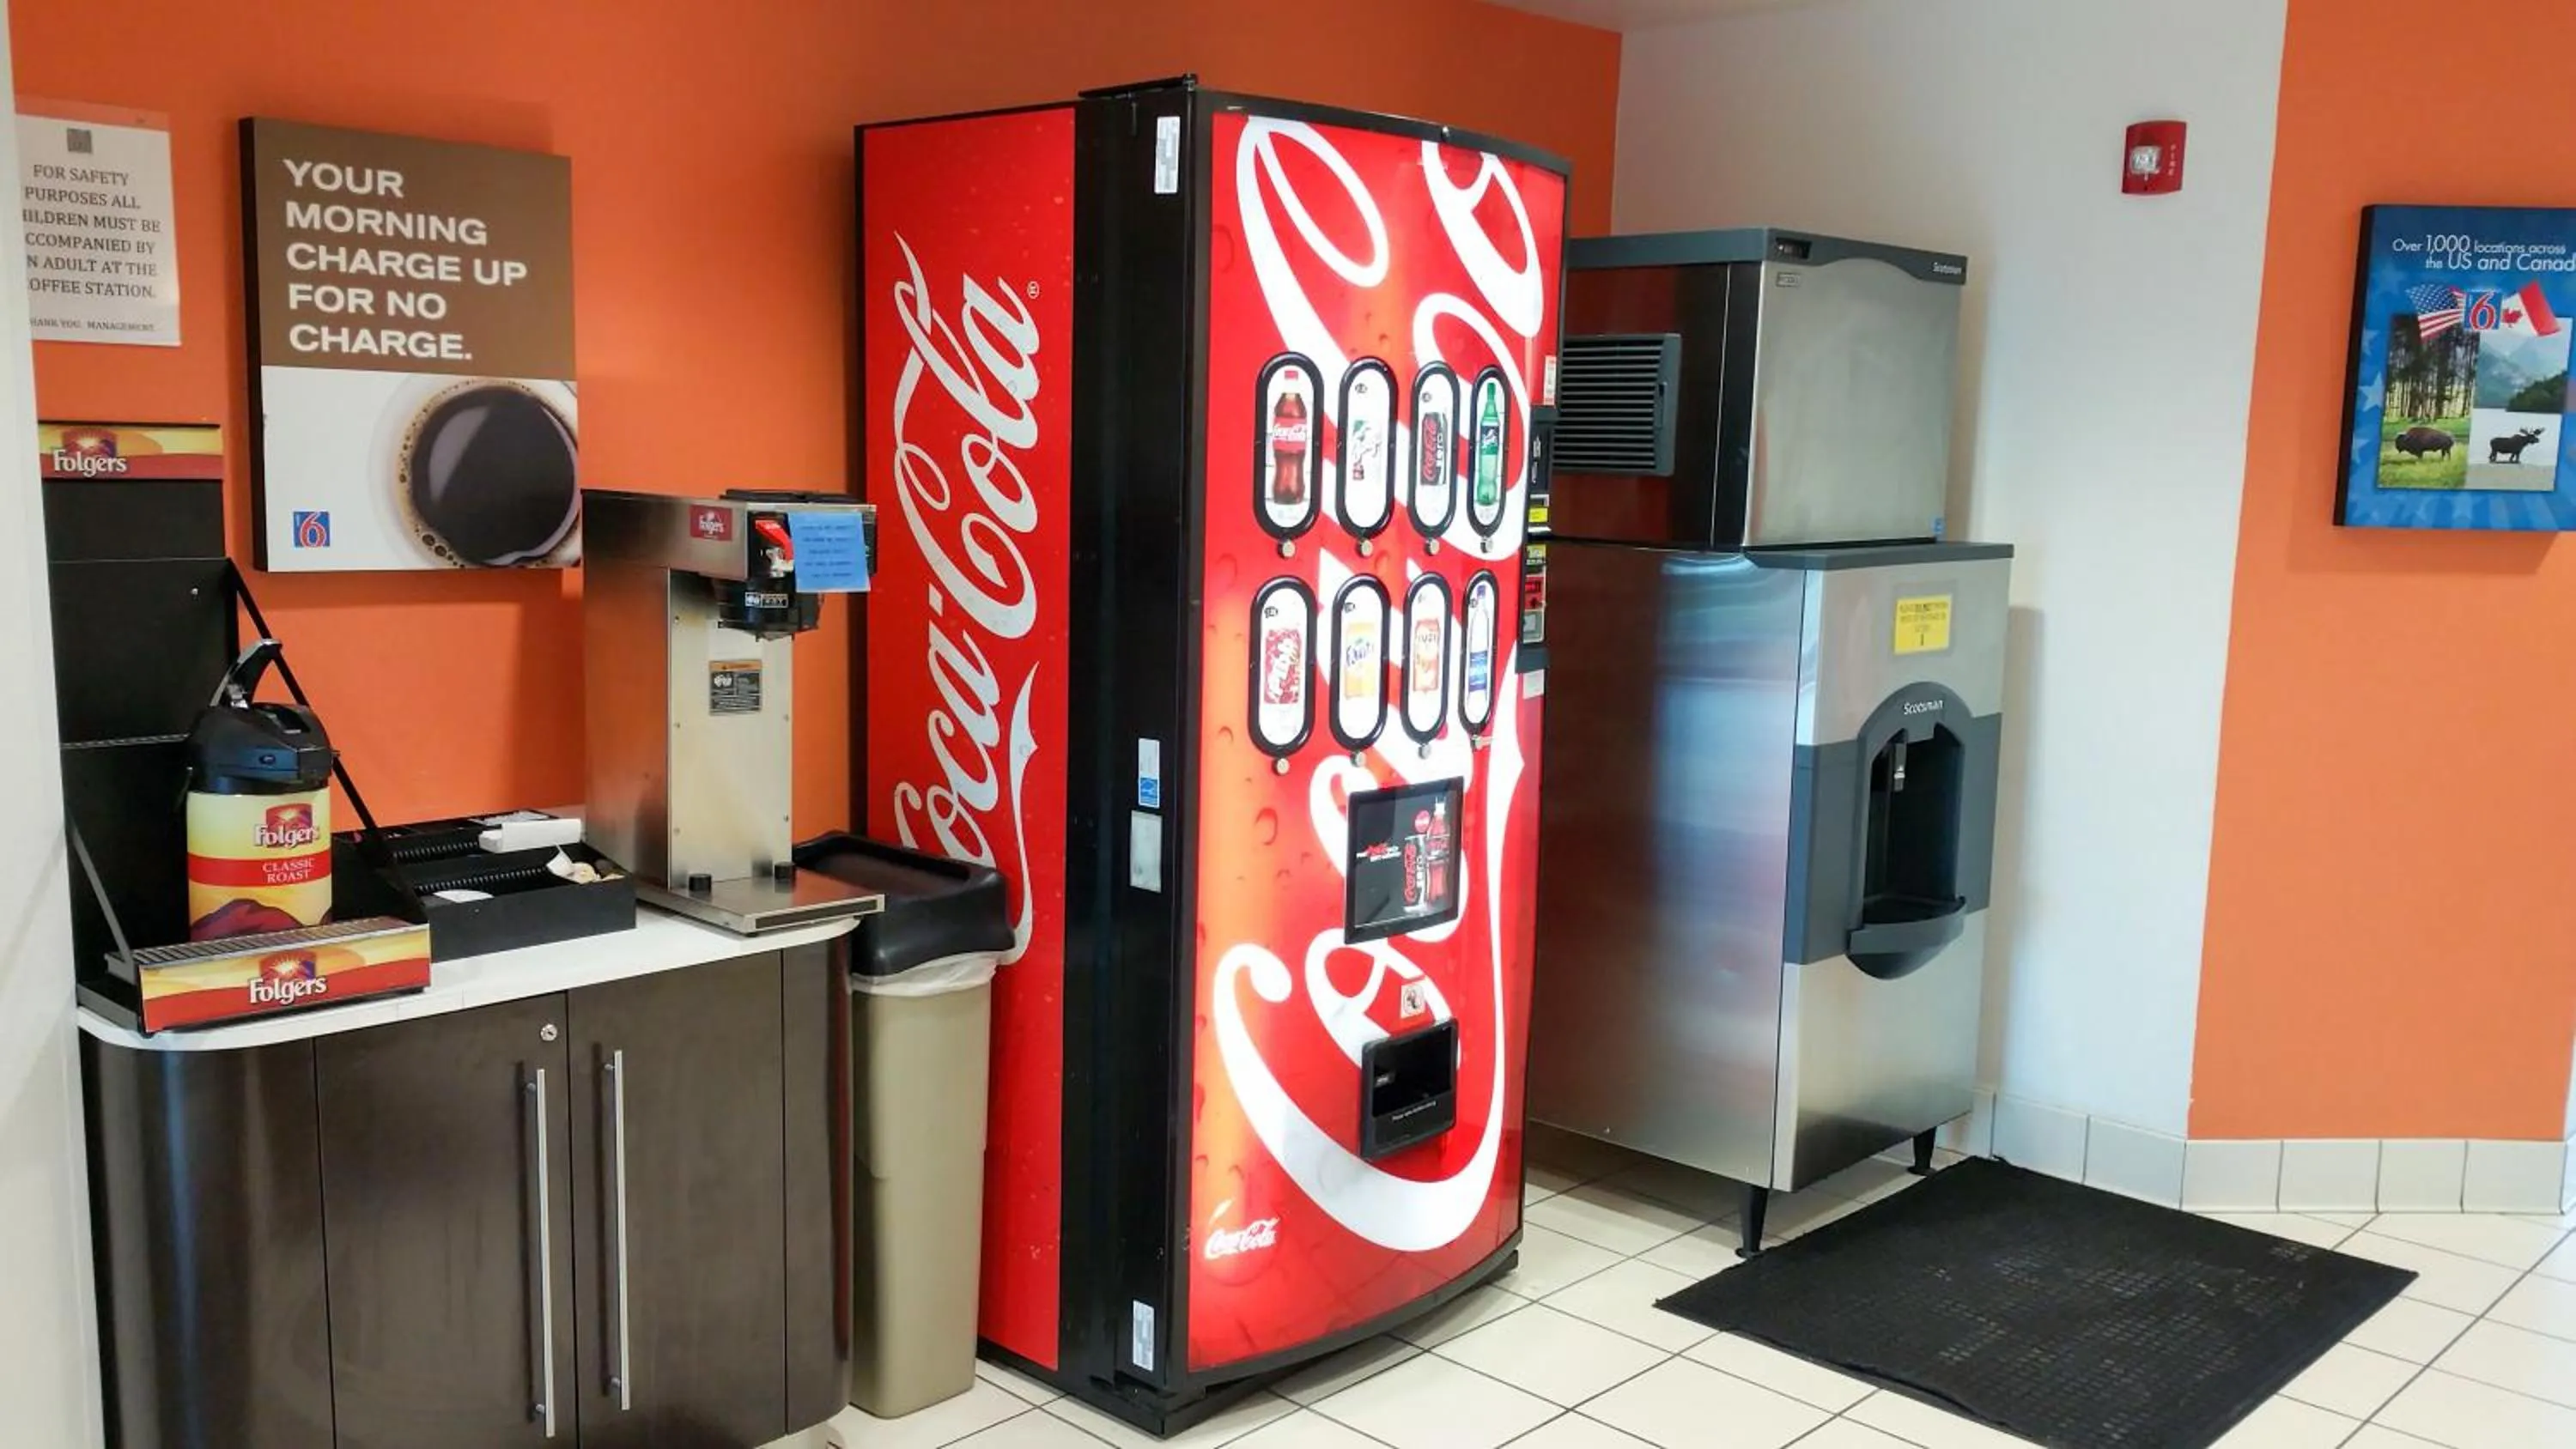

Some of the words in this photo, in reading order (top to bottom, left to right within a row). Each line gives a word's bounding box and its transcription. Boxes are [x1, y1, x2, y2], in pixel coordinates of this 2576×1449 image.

[33, 164, 66, 179] FOR
[70, 167, 130, 186] SAFETY
[283, 159, 404, 198] YOUR
[25, 186, 107, 207] PURPOSES
[111, 196, 141, 209] ALL
[94, 215, 137, 231] MUST
[142, 219, 161, 233] BE
[286, 200, 488, 246] MORNING
[25, 232, 131, 252] CCOMPANIED
[137, 240, 156, 255] BY
[2392, 238, 2422, 252] Over
[2426, 234, 2471, 256] 1,000
[2474, 240, 2525, 254] locations
[2529, 245, 2567, 254] across
[27, 255, 38, 269] N
[43, 257, 97, 273] ADULT
[101, 260, 123, 274] AT
[125, 262, 158, 276] THE
[286, 242, 462, 282] CHARGE
[473, 258, 528, 286] UP
[2425, 258, 2443, 269] the
[2448, 252, 2472, 270] US
[2477, 252, 2512, 270] and
[2517, 252, 2576, 271] Canad
[29, 277, 81, 294] OFFEE
[289, 282, 376, 314] FOR
[386, 289, 447, 320] NO
[2470, 291, 2495, 330] 6
[30, 317, 60, 327] HANK
[289, 323, 472, 361] CHARGE.
[52, 448, 128, 477] Folgers
[300, 511, 327, 548] 6
[253, 824, 319, 849] Folgers
[262, 858, 316, 873] CLASSIC
[267, 868, 312, 884] ROAST
[249, 977, 327, 1005] Folgers
